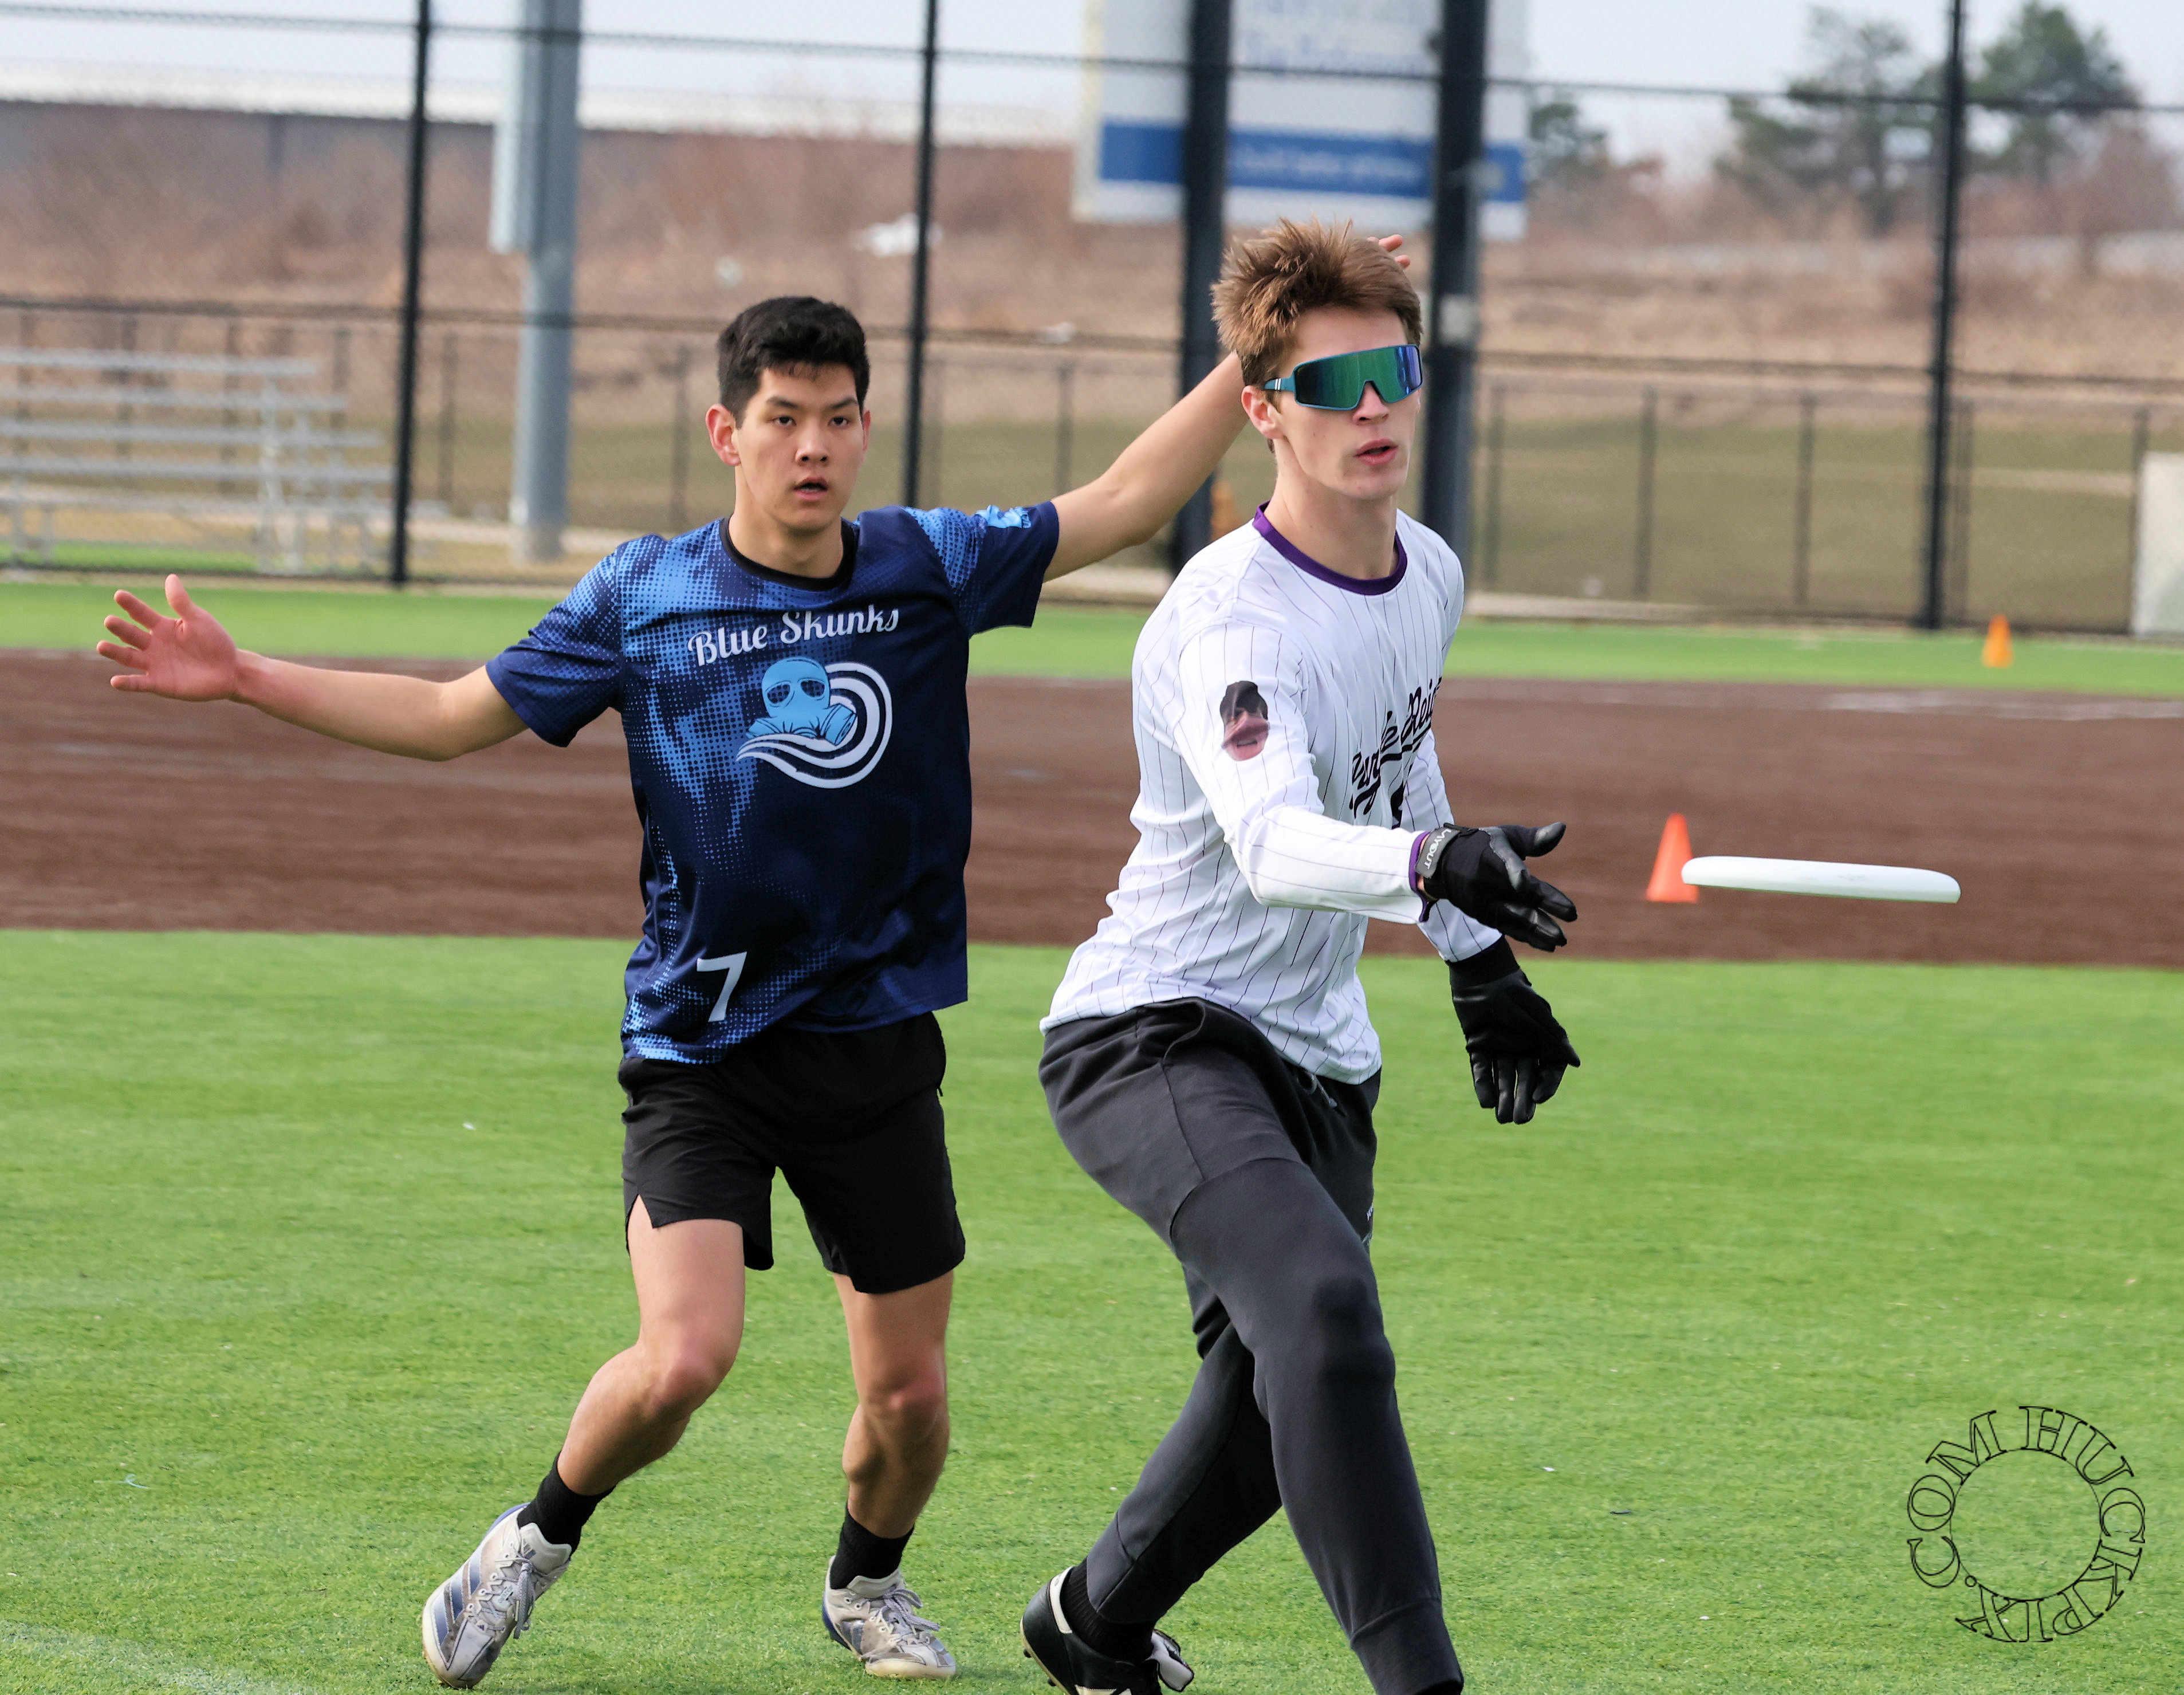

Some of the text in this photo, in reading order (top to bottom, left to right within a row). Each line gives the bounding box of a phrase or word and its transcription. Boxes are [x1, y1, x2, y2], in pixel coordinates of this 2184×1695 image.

[688, 604, 899, 666] Blue Skunks
[1424, 828, 1452, 870] LAYOUT
[696, 951, 747, 1022] 7
